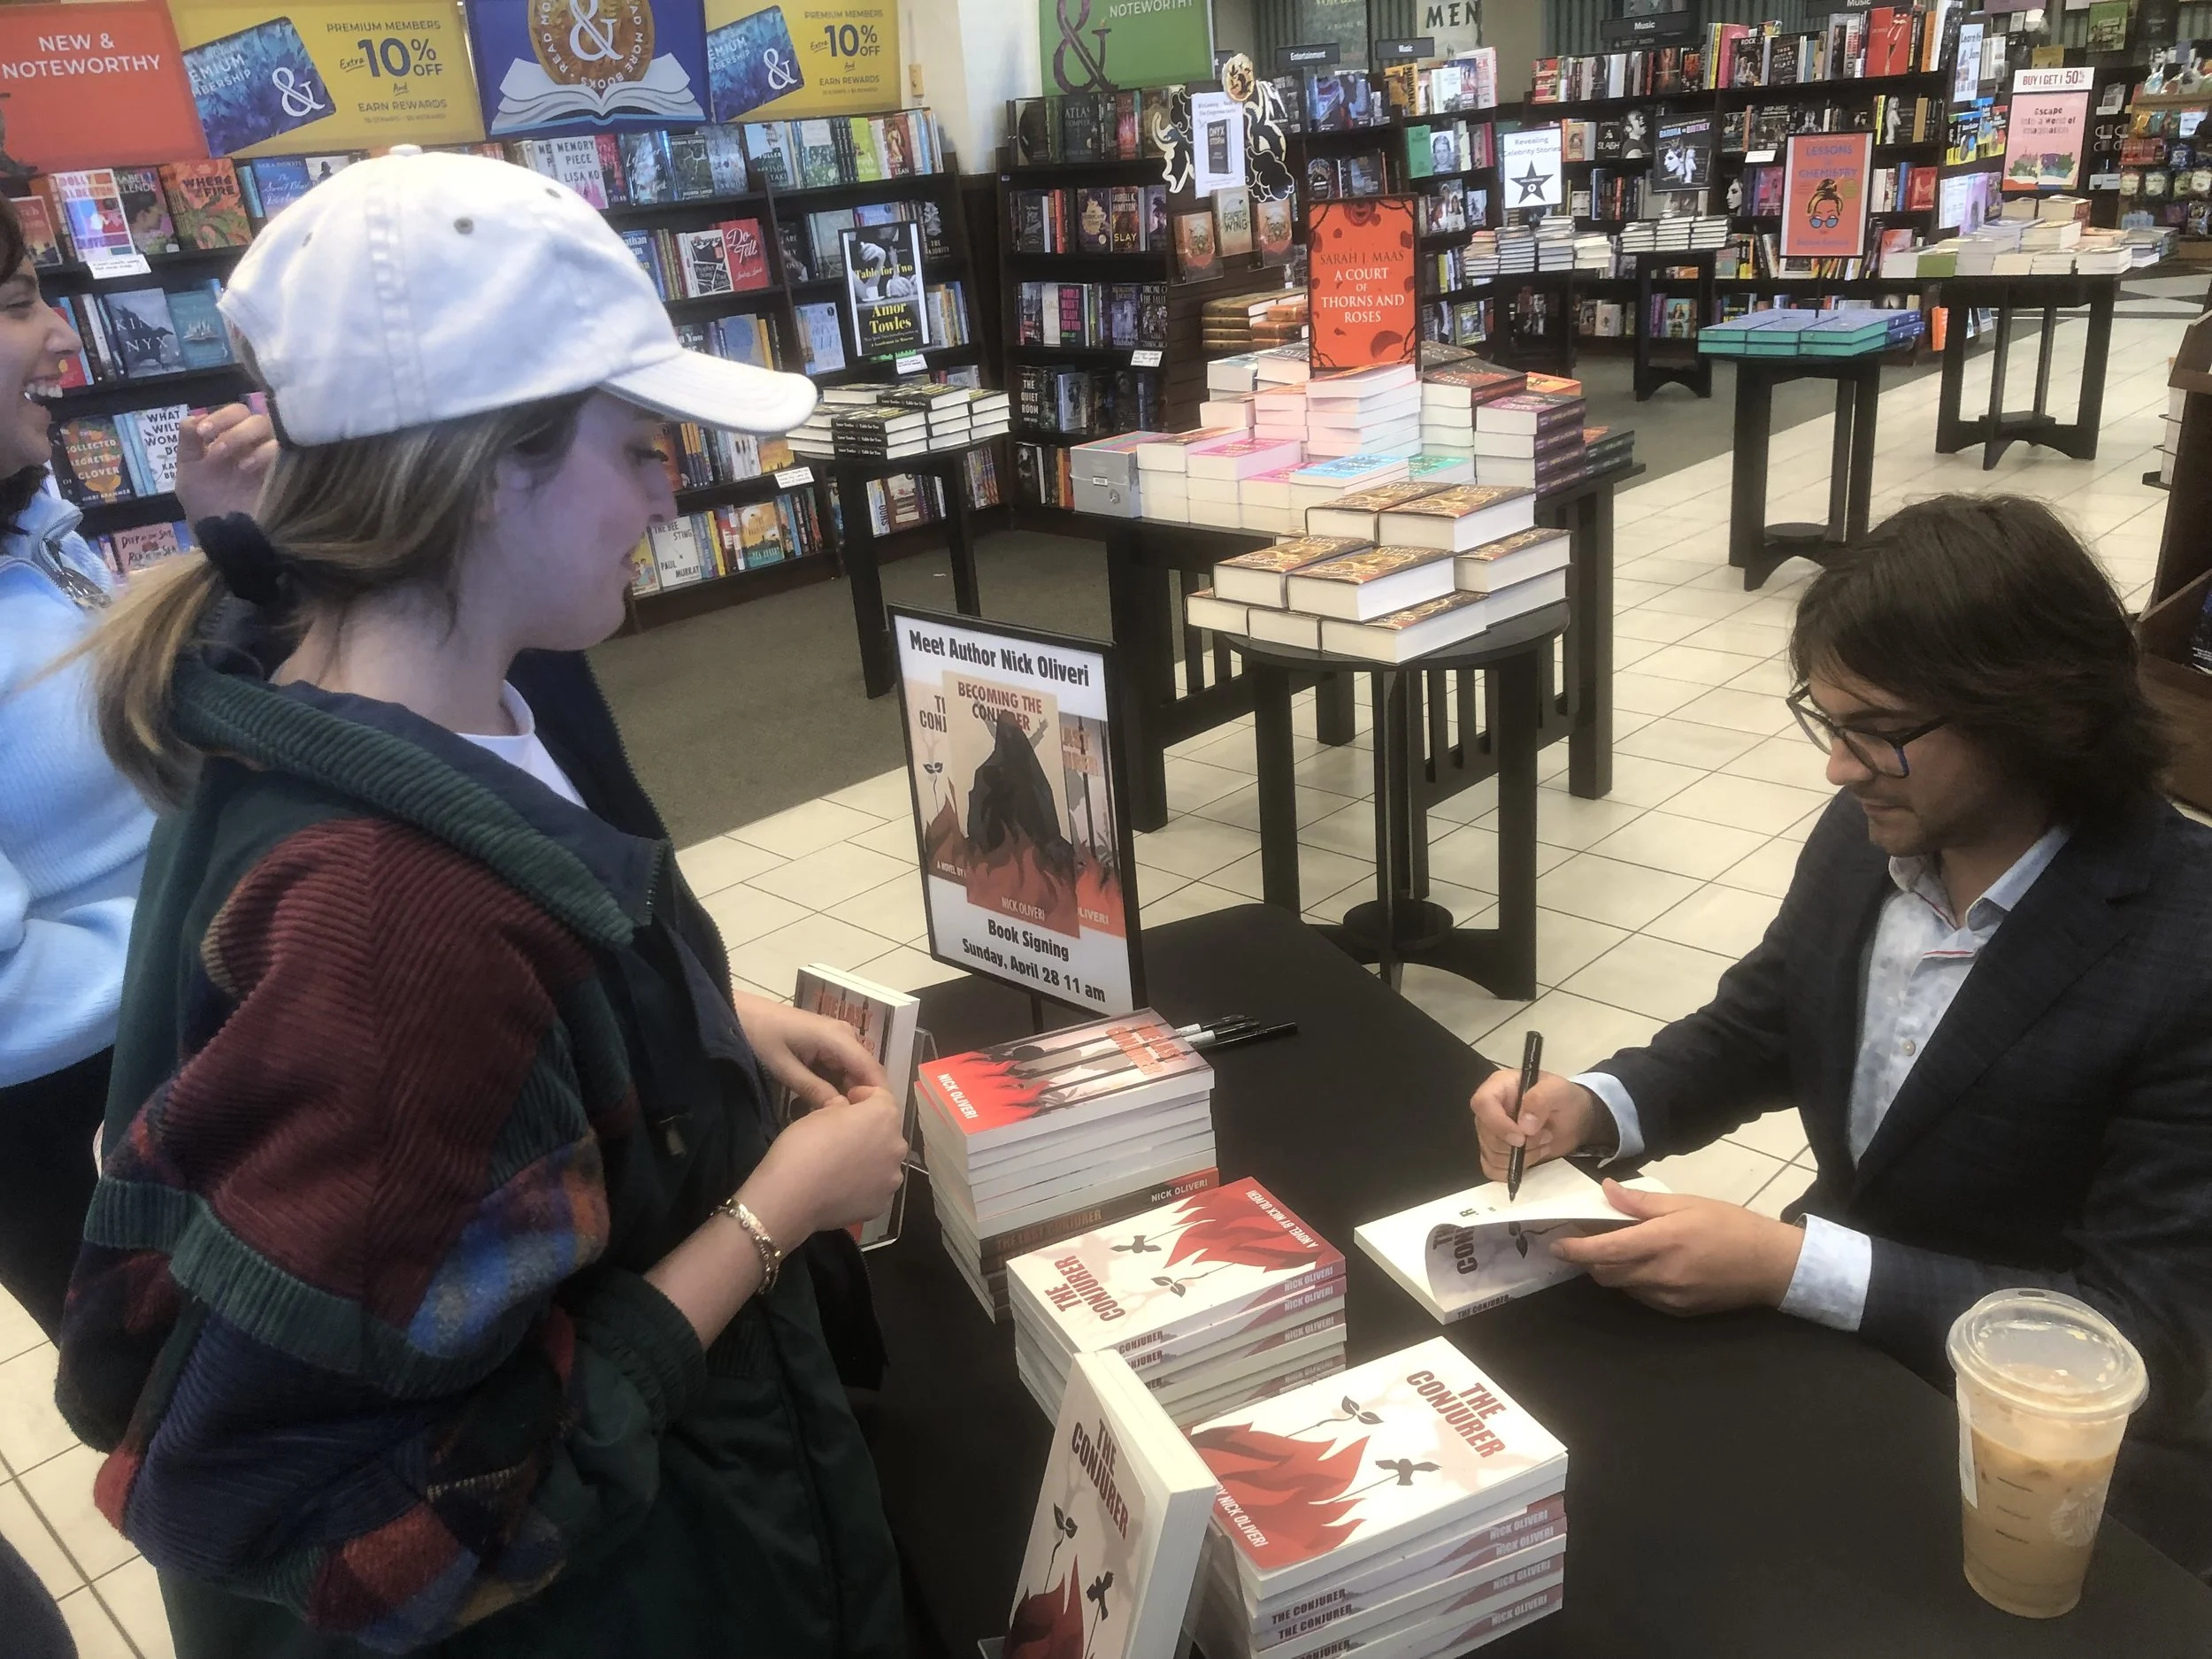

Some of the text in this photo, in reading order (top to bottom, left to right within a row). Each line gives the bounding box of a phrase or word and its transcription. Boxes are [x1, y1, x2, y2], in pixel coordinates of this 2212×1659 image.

[845, 9, 884, 19] MEMBERS
[1425, 2, 1481, 28] MEN
[326, 20, 442, 33] PREMIUM MEMBERS
[1634, 21, 1655, 30] Music
[39, 33, 115, 52] NEW &
[860, 46, 880, 57] OFF
[1290, 50, 1326, 61] Entertainment
[1969, 47, 1980, 59] Jam
[2, 54, 160, 80] NOTEWORTHY
[340, 58, 365, 71] Extra
[543, 32, 643, 89] MORE BOOKS READ
[413, 64, 443, 77] OFF
[842, 75, 879, 85] REWARDS
[1405, 66, 1417, 107] NIRVANA
[2023, 74, 2058, 85] BUY GET
[273, 67, 326, 117] &
[357, 98, 449, 112] EARN REWARDS
[2034, 107, 2063, 116] Escape
[1209, 126, 1225, 136] ONYX
[557, 139, 595, 153] MEMORY
[1515, 136, 1549, 146] Revealing
[1597, 141, 1620, 150] SLASH
[1504, 145, 1562, 157] Celebrity Stories
[1806, 145, 1853, 157] LESSONS
[565, 154, 592, 165] PIECE
[565, 170, 600, 183] LISA KO
[1799, 167, 1857, 178] CHEMISTRY
[181, 175, 233, 188] WHERE
[203, 186, 235, 198] FIRE
[1225, 219, 1248, 233] WING
[726, 228, 751, 247] Do
[1113, 233, 1137, 242] SLAY
[733, 238, 758, 264] Tell
[1319, 250, 1405, 265] SARAH MAAS
[855, 264, 913, 280] Table for Two
[1334, 267, 1390, 281] A COURT
[1356, 282, 1368, 292] OF
[1321, 294, 1405, 308] THORNS AND
[872, 303, 907, 319] Amor
[1344, 311, 1382, 323] ROSES
[869, 319, 912, 334] Towles
[126, 336, 168, 352] NYX
[1023, 380, 1035, 389] THE
[1020, 392, 1038, 403] QUIET
[1021, 403, 1039, 414] ROOM
[146, 410, 180, 424] WHAT
[77, 466, 120, 481] CLOVER
[666, 521, 679, 531] BEE
[673, 529, 693, 541] STING
[660, 561, 678, 572] PAUL
[675, 565, 700, 579] MURRAY
[909, 629, 1090, 687] Meet Author Nick Oliveri
[957, 681, 1018, 709] BECOMING
[1021, 694, 1042, 715] THE
[941, 862, 956, 876] NOVEL
[1002, 896, 1045, 922] NICK OLIVERI
[1078, 905, 1110, 925] LIVERI
[987, 918, 1070, 962] Book Signing
[962, 938, 1106, 1002] Sunday, April 28 11 am
[1136, 1022, 1187, 1064] THE LAST
[937, 1072, 979, 1119] NICK OLIVERI
[1151, 1179, 1208, 1202] NICK OLIVERI
[1049, 1210, 1102, 1235] CONJURER
[1245, 1190, 1313, 1247] NOVEL BY NICK OLIVERI
[1284, 1267, 1333, 1293] NICK OLIVERI
[1054, 1255, 1126, 1323] CONJURER
[1045, 1283, 1083, 1313] THE
[1284, 1286, 1333, 1311] NICK OLIVERI
[1458, 1308, 1471, 1318] THE
[1284, 1316, 1334, 1341] NICK OLIVERI
[1119, 1330, 1164, 1355] CONJURER
[1458, 1382, 1507, 1420] THE
[1406, 1371, 1506, 1458] CONJURER
[1096, 1417, 1117, 1479] THE
[1071, 1421, 1129, 1540] CONJURER
[1217, 1493, 1269, 1548] NICK OLIVERI
[1490, 1509, 1548, 1540] NICK OLIVERI
[1495, 1526, 1555, 1556] NICK OLIVERI
[1494, 1560, 1551, 1590] NICK OLIVERI
[1271, 1588, 1347, 1625] THE CONJURER
[1492, 1594, 1548, 1626] NICK OLIVERI
[1279, 1604, 1352, 1640] THE CONJURER
